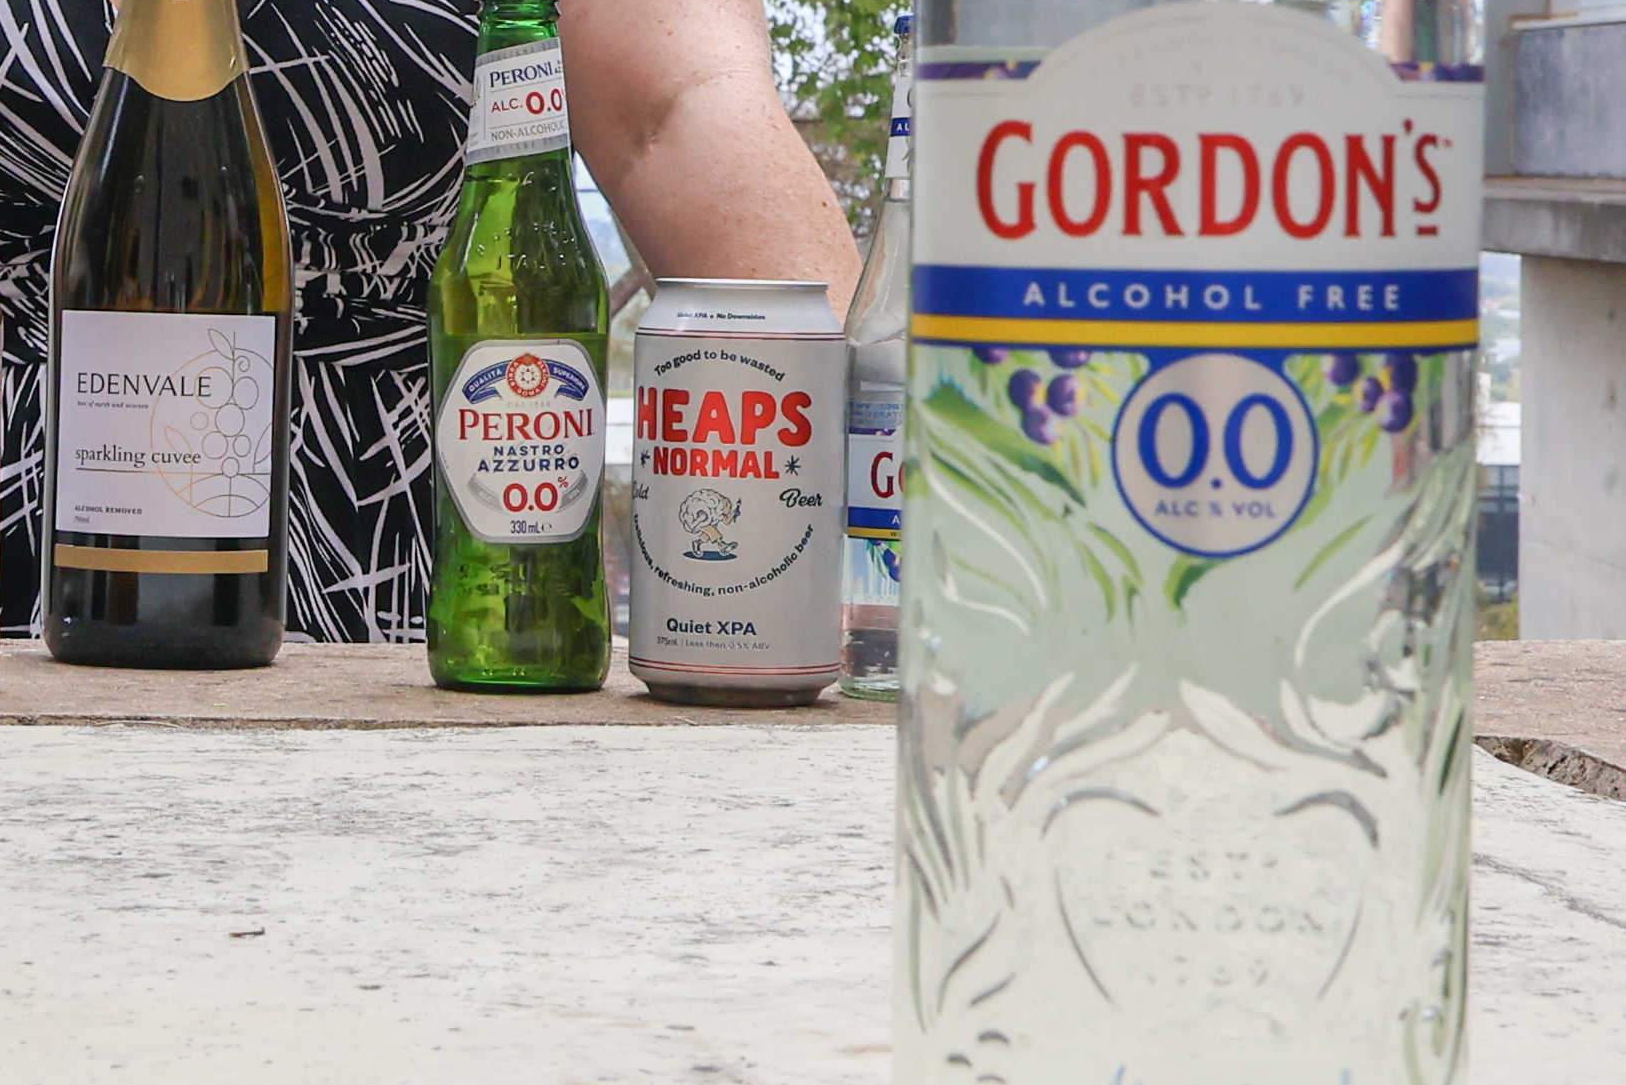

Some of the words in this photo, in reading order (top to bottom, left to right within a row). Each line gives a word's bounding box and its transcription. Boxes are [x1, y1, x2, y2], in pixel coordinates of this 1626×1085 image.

[490, 61, 553, 88] PERONI
[491, 97, 524, 113] ALC.
[976, 118, 1442, 240] GORDON'S
[1024, 282, 1262, 310] ALCOHOL
[1298, 285, 1400, 310] FREE
[654, 361, 672, 376] Too
[673, 350, 701, 369] good
[704, 350, 717, 360] to
[720, 349, 737, 361] be
[740, 355, 786, 382] wasted
[77, 372, 212, 398] EDENVALE
[459, 408, 593, 440] PERONI
[637, 385, 812, 447] HEAPS
[494, 444, 564, 456] NASTRO
[1138, 393, 1295, 491] 0.0
[75, 444, 146, 468] sparkling
[151, 449, 202, 465] cuvee
[478, 457, 580, 472] AZZURRO
[653, 446, 780, 479] NORMAL
[74, 505, 103, 513] ALCOHOL
[105, 506, 143, 515] REMOVED
[779, 488, 823, 508] Beer
[1154, 499, 1199, 517] ALC
[1231, 500, 1276, 518] VOL
[654, 566, 715, 598] refreshing,
[718, 554, 798, 595] non-alcoholic
[798, 524, 814, 553] beer
[667, 618, 712, 634] Quiet
[716, 620, 757, 636] XPA
[685, 638, 704, 648] Less
[706, 638, 726, 649] than
[751, 642, 771, 650] ABV
